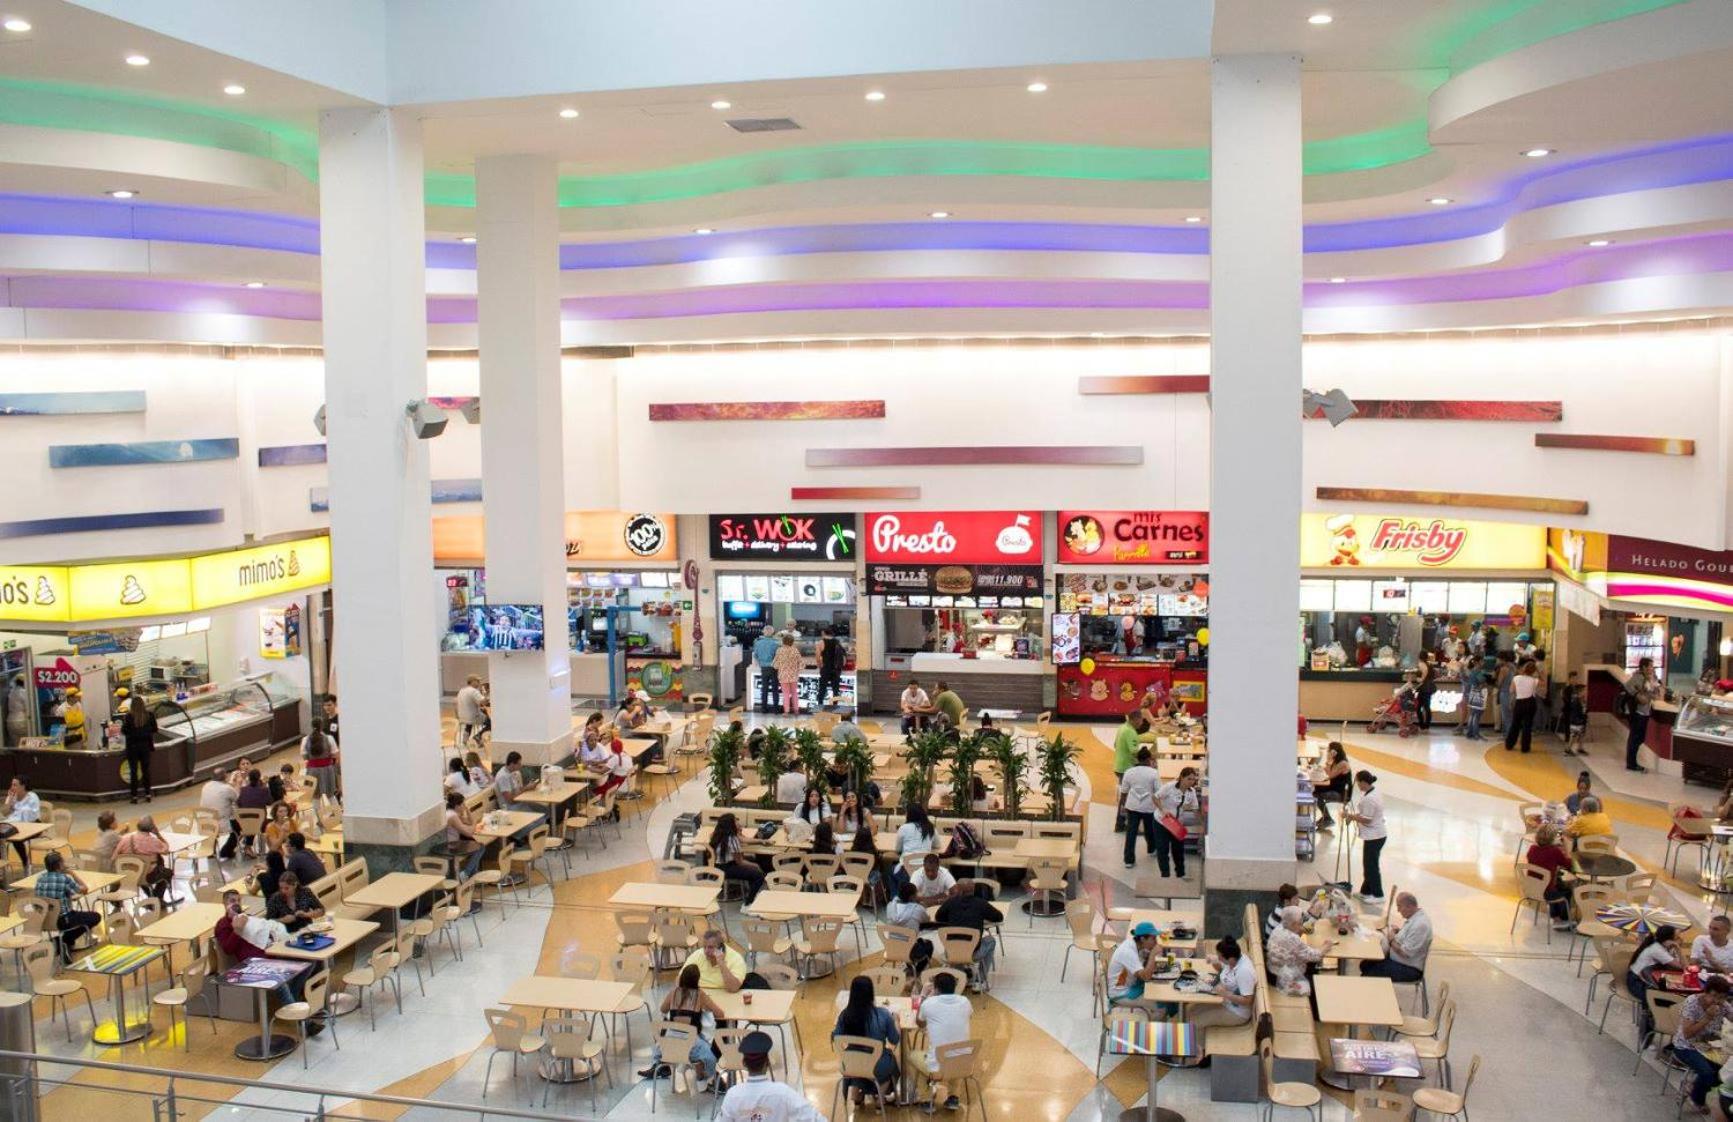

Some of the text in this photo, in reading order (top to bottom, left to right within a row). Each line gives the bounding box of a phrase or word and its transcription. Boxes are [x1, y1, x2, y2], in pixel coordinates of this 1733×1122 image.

[720, 518, 815, 541] Sr. WOK
[873, 514, 957, 553] Presto
[1114, 518, 1204, 542] Carnes
[1372, 519, 1467, 566] Frisby
[240, 554, 285, 587] mimo's
[874, 568, 928, 582] GRILLÉ
